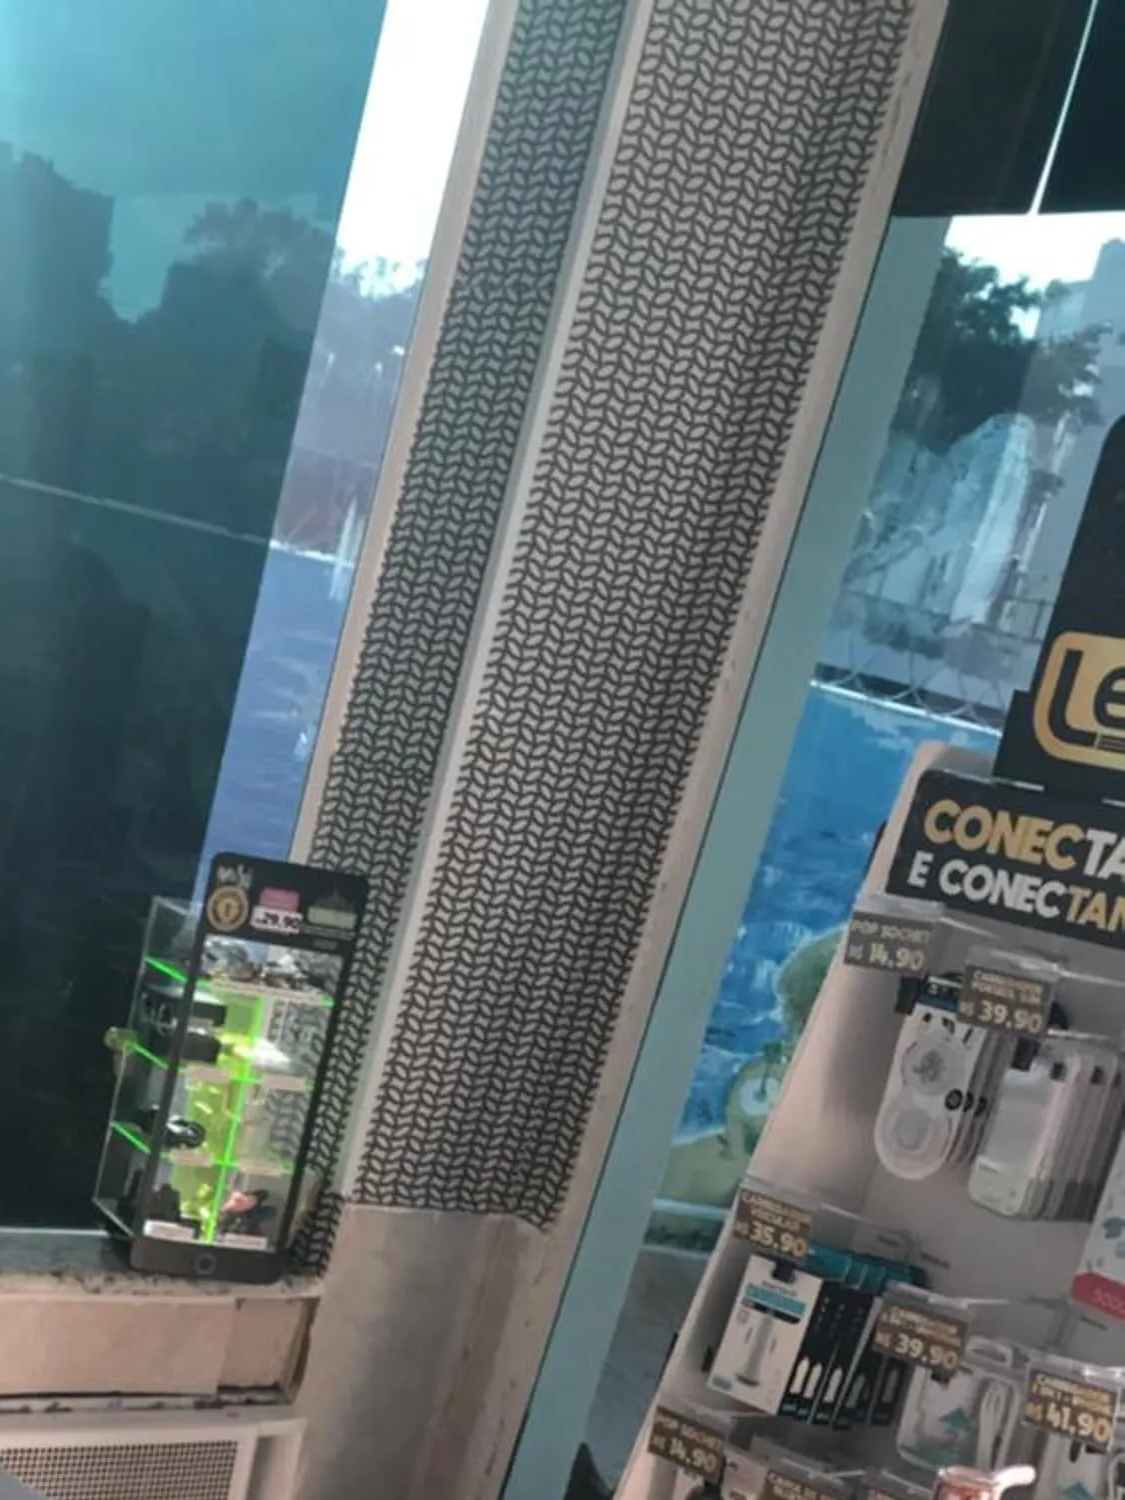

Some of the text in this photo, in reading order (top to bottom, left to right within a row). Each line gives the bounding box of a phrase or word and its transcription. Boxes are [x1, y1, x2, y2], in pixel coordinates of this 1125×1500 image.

[907, 851, 934, 888] E
[977, 1000, 1043, 1033] 39.90
[894, 1334, 959, 1369] 39.90
